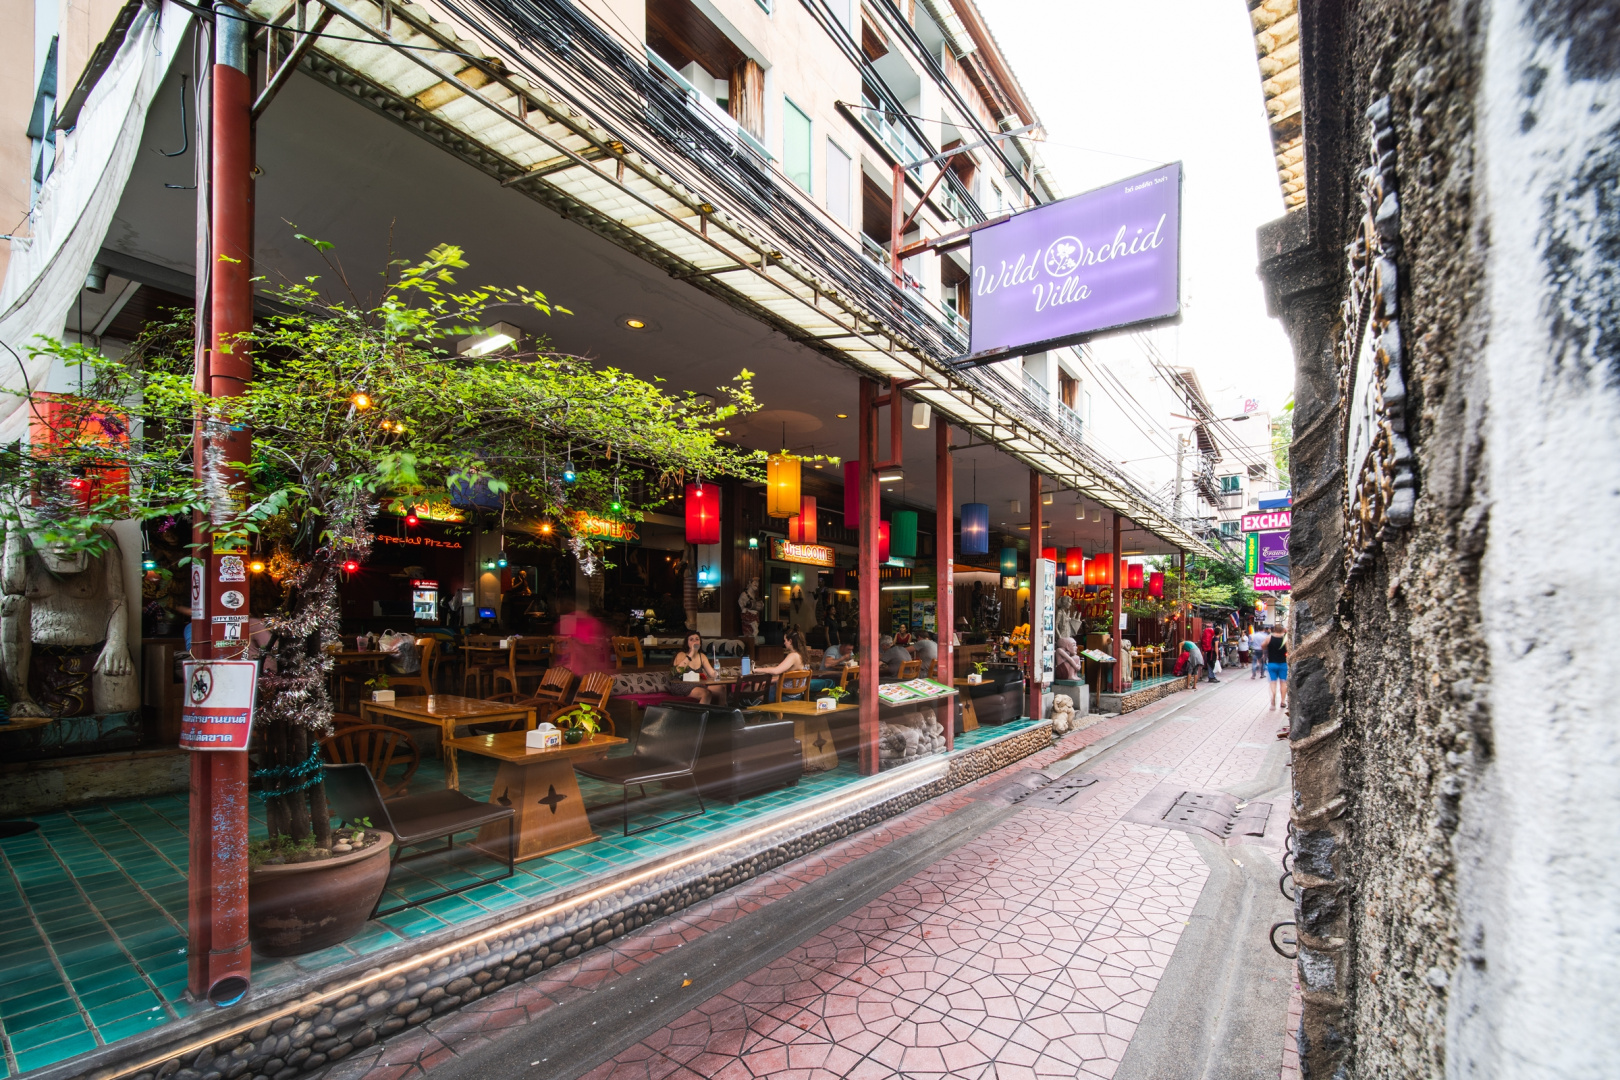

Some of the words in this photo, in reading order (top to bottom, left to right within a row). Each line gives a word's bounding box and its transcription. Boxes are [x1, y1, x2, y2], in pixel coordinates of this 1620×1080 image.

[974, 248, 1041, 296] Wild
[1032, 275, 1092, 312] Villa
[589, 514, 640, 541] STEAK
[1243, 512, 1292, 530] EXCHA
[784, 541, 833, 563] WELCOME
[1075, 603, 1114, 618] Vill
